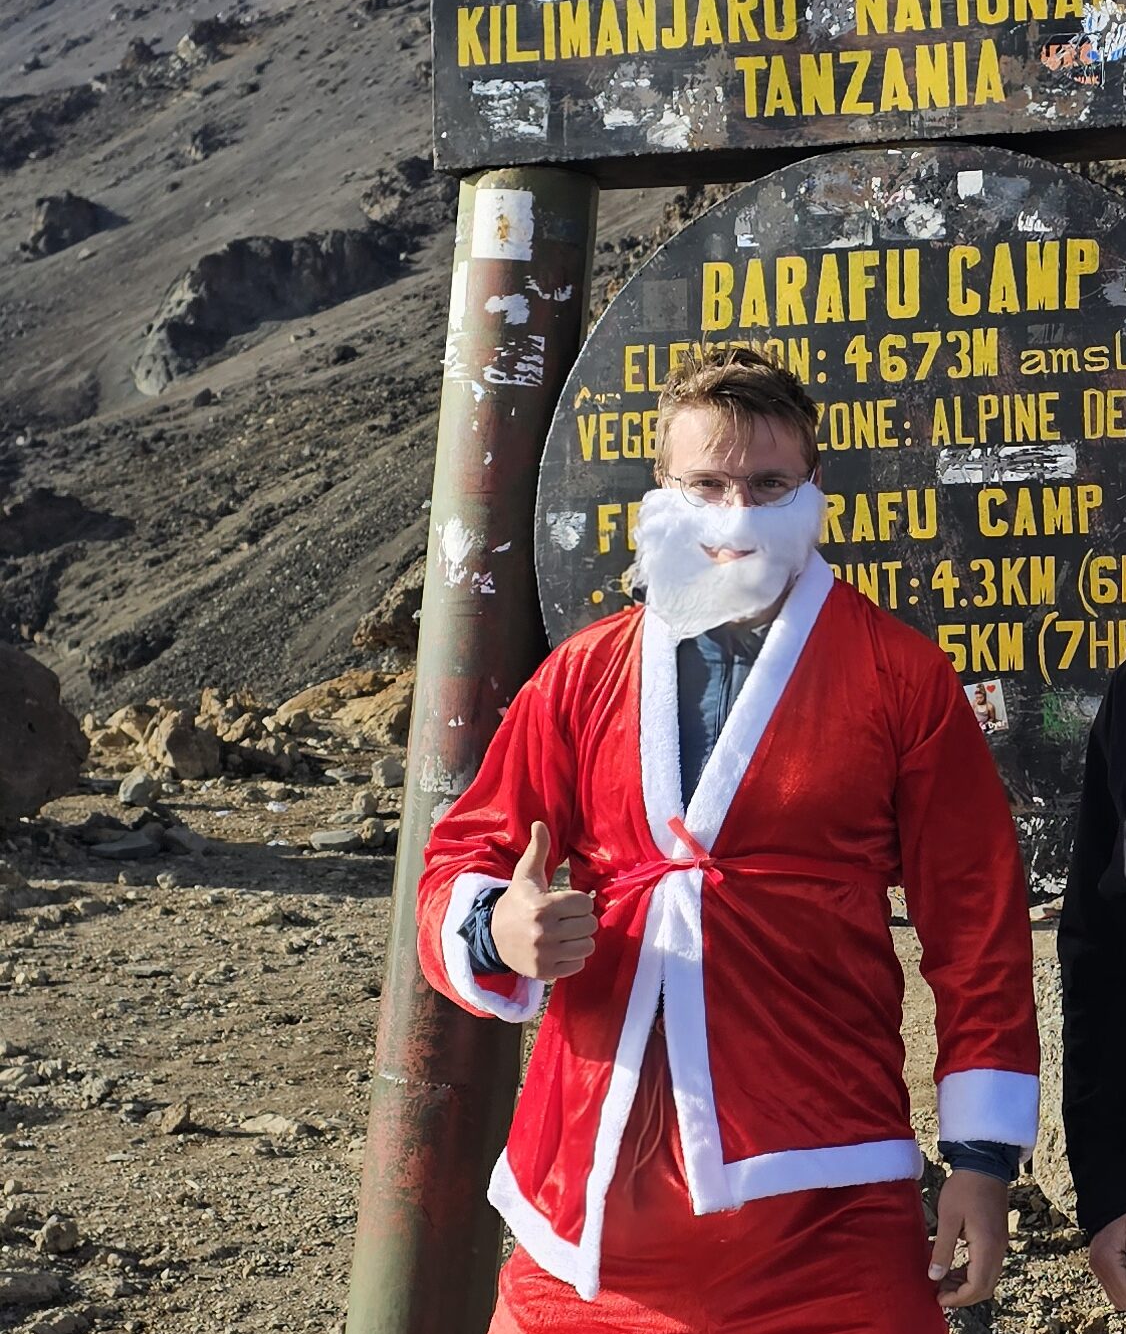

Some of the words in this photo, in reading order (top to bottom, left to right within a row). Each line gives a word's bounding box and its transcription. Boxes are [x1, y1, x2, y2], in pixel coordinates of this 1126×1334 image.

[735, 38, 1006, 118] TANZANIA
[702, 248, 920, 331] BARAFU
[948, 238, 1099, 316] CAMP
[844, 328, 999, 383] 4673M
[931, 392, 1060, 447] ALPINE
[819, 489, 938, 544] RAFU
[977, 484, 1102, 537] CAMP
[931, 556, 1056, 609] 4.3KM
